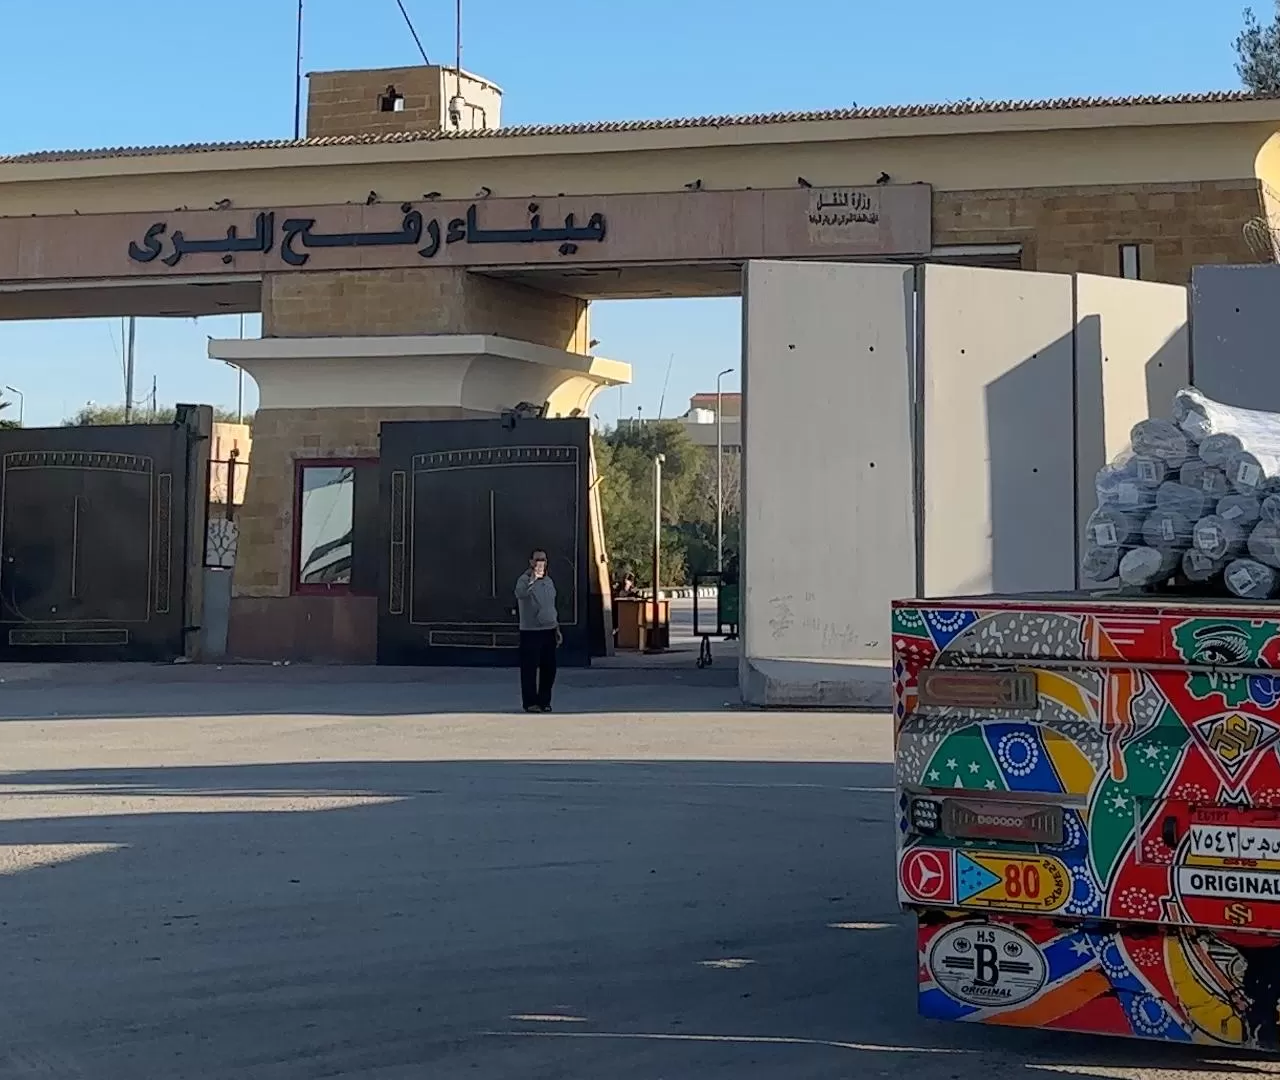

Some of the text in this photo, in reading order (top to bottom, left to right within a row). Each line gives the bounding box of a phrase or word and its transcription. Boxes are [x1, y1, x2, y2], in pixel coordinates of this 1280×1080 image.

[280, 201, 440, 266] رفح
[446, 202, 607, 256] ميناء
[1192, 829, 1236, 853] ٧٥٤٣
[1004, 863, 1040, 899] 80
[976, 930, 996, 943] H.S
[973, 943, 999, 987] B
[961, 985, 1012, 997] ORIGINAL
